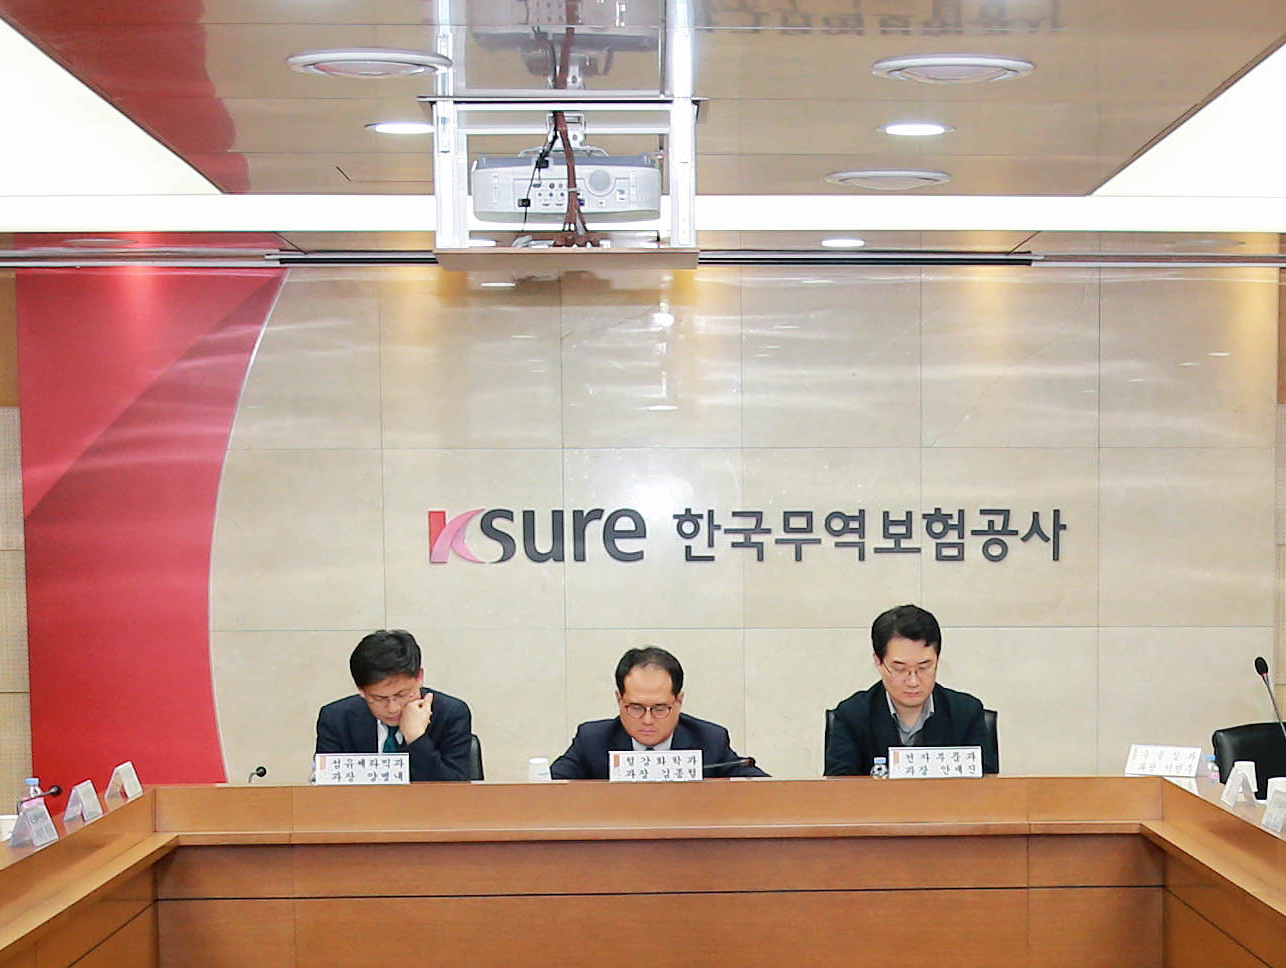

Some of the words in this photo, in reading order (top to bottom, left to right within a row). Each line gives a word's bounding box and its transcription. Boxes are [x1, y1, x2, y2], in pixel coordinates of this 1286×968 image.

[428, 507, 647, 565] Ksure
[673, 507, 1067, 563] 한국무역보험공사
[626, 768, 649, 779] 과장
[906, 765, 929, 776] 과장
[331, 771, 355, 782] 과장
